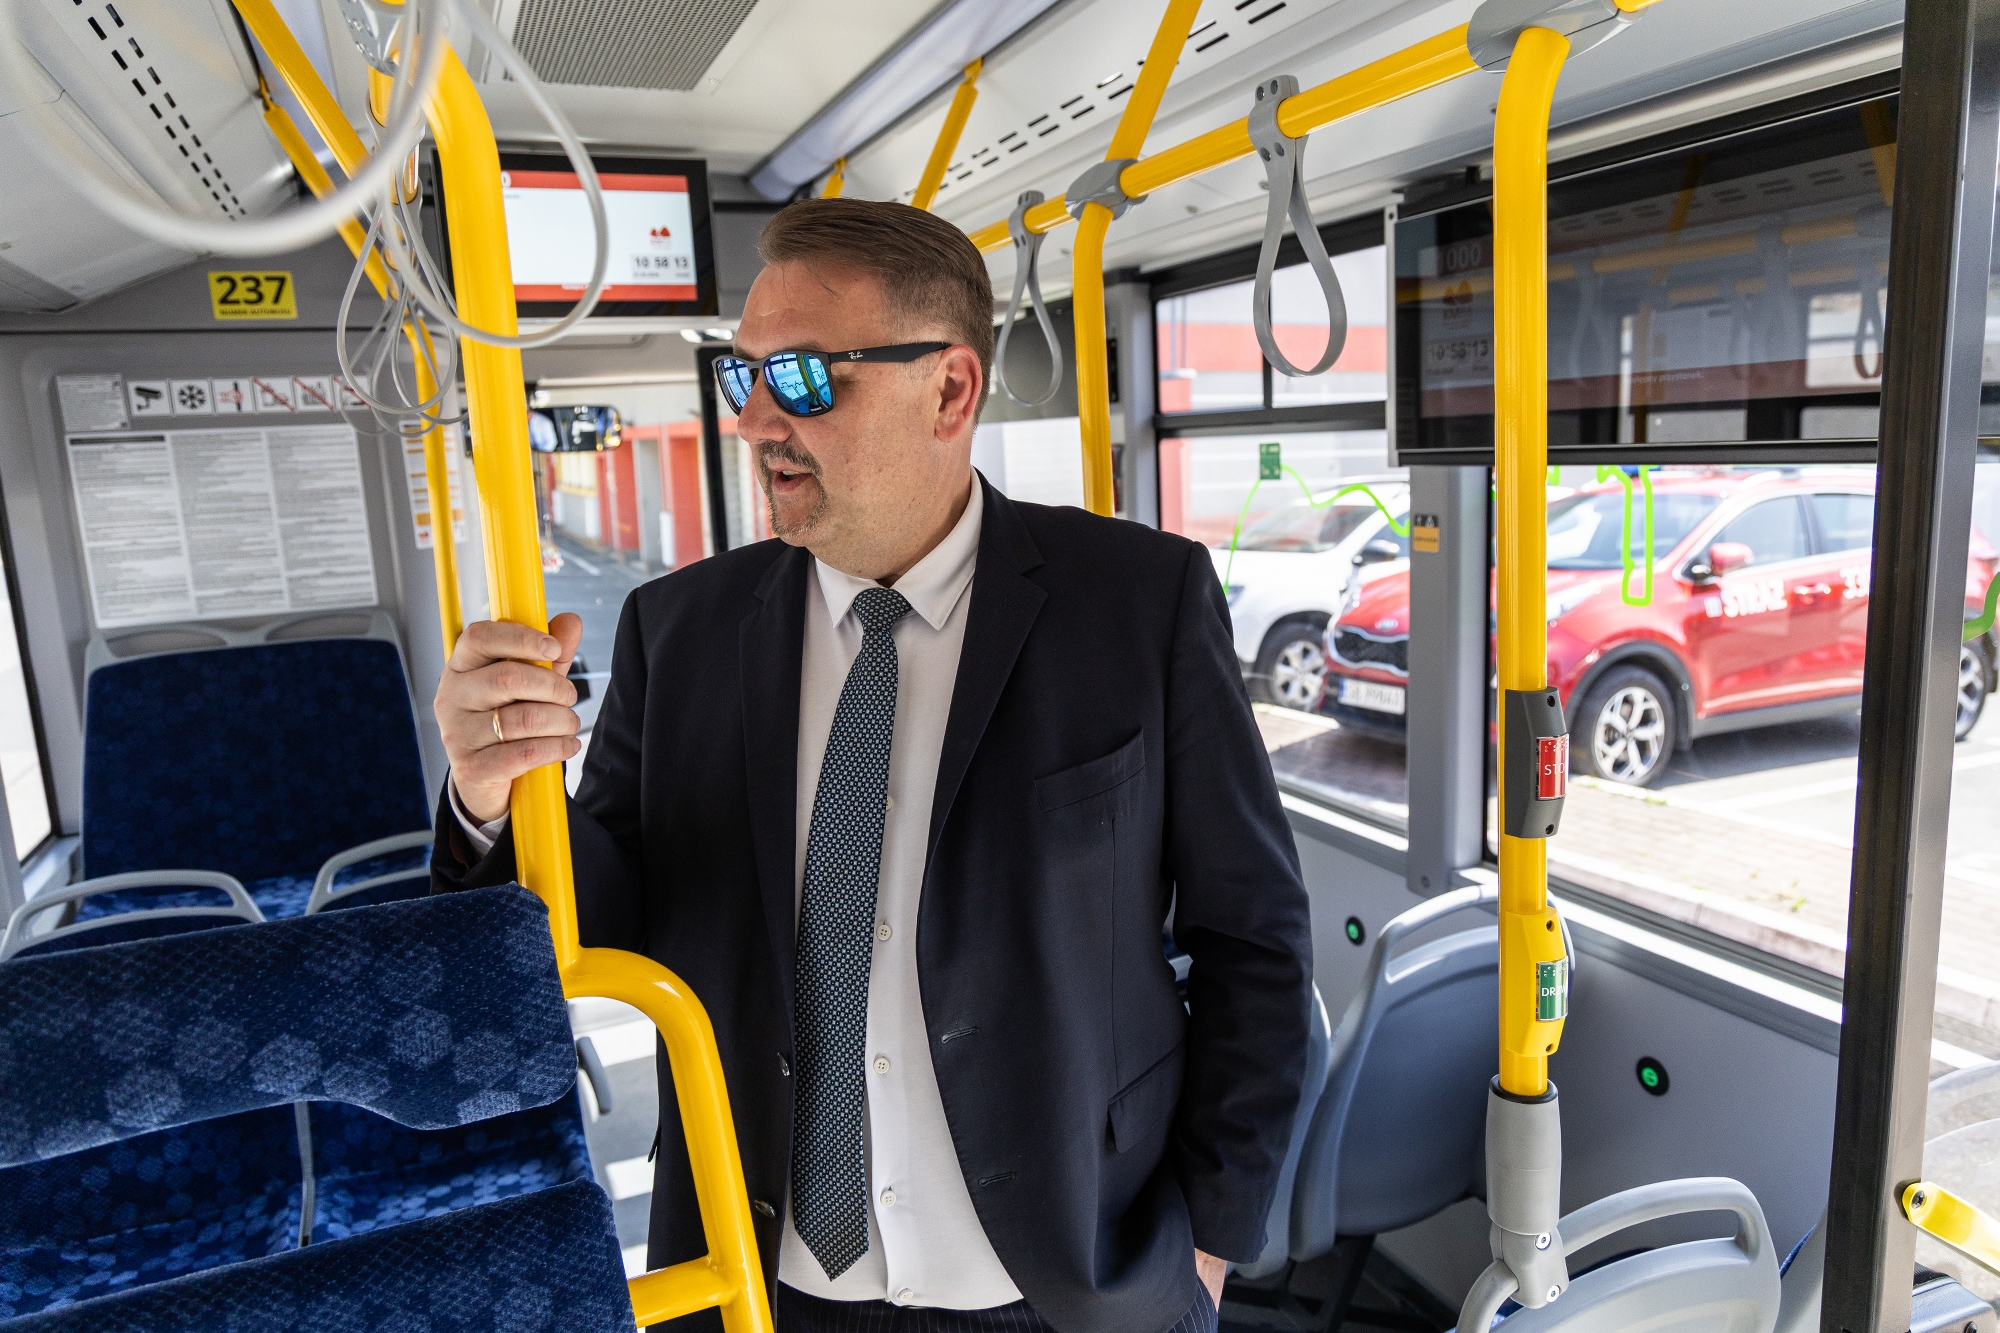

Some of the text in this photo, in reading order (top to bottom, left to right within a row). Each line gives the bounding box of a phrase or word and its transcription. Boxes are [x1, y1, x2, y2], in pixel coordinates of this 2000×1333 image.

[216, 275, 287, 305] 237
[1544, 762, 1566, 776] STO
[1541, 984, 1567, 997] DRZW
